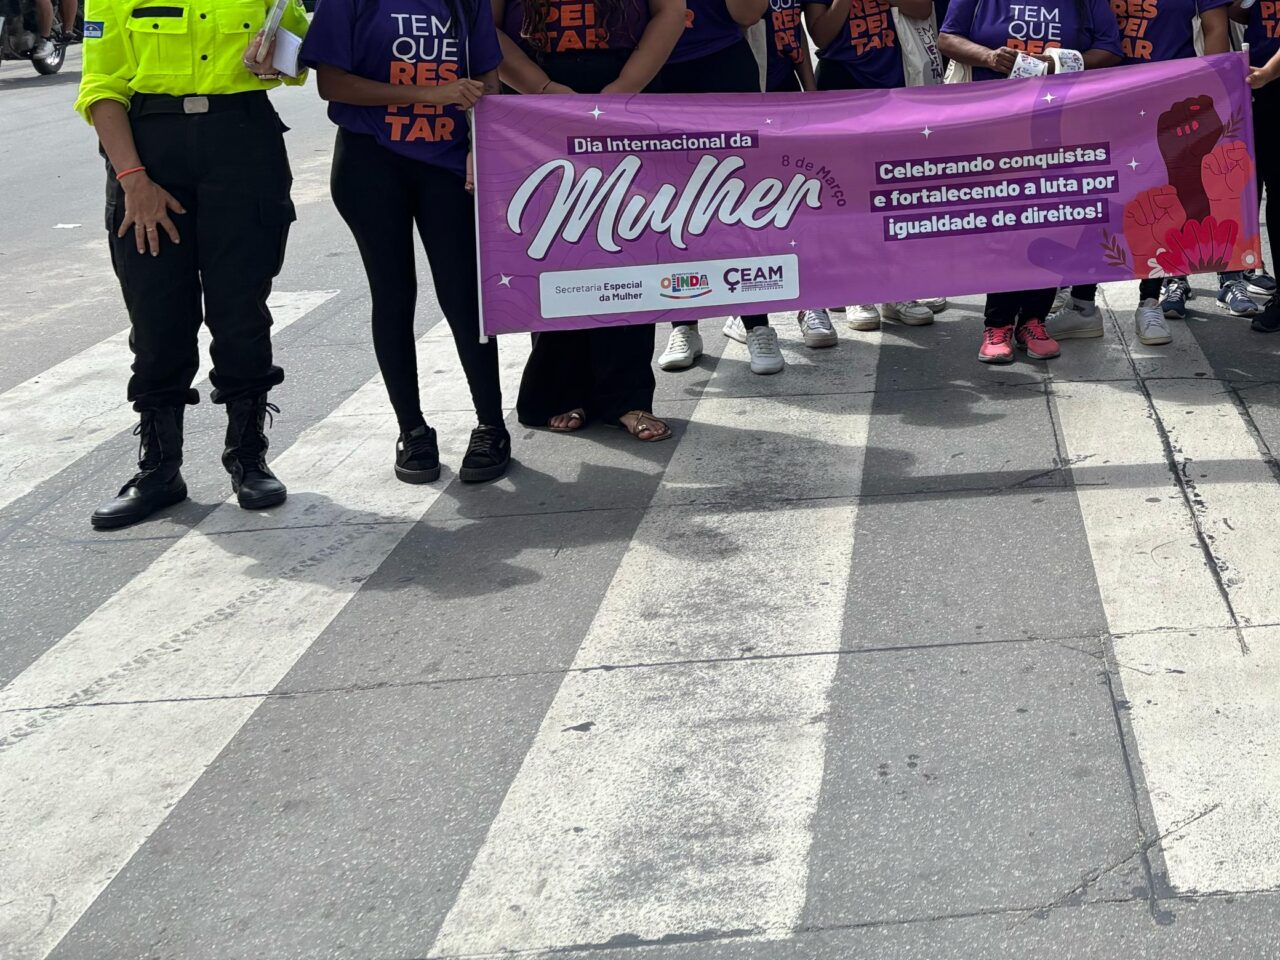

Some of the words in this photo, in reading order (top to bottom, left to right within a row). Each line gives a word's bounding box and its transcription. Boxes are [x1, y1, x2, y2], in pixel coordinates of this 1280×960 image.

[391, 14, 454, 36] TEM
[849, 13, 888, 37] PEI
[1010, 5, 1059, 22] TEM
[851, 30, 895, 55] TAR
[1008, 21, 1061, 40] QUE
[392, 37, 459, 63] QUE
[1122, 38, 1153, 59] AR
[390, 62, 458, 86] RES
[385, 116, 455, 141] TAR
[574, 137, 602, 153] Dia
[607, 134, 725, 152] Internacional
[730, 133, 752, 148] da
[879, 157, 995, 180] Celebrando
[999, 148, 1107, 169] conquistas
[781, 155, 790, 168] 8
[795, 154, 814, 172] de
[815, 166, 847, 208] Março
[873, 195, 886, 207] e
[891, 180, 1020, 206] fortalecendo
[1024, 182, 1036, 195] a
[1040, 177, 1078, 194] luta
[1082, 175, 1115, 194] por
[506, 154, 823, 261] Mulher
[888, 216, 988, 239] igualdade
[992, 210, 1016, 227] de
[1020, 202, 1103, 225] direitos!
[555, 283, 602, 294] Secretaria
[604, 281, 643, 291] Especial
[723, 265, 783, 288] CEAM
[599, 293, 611, 302] da
[612, 291, 643, 301] Mulher
